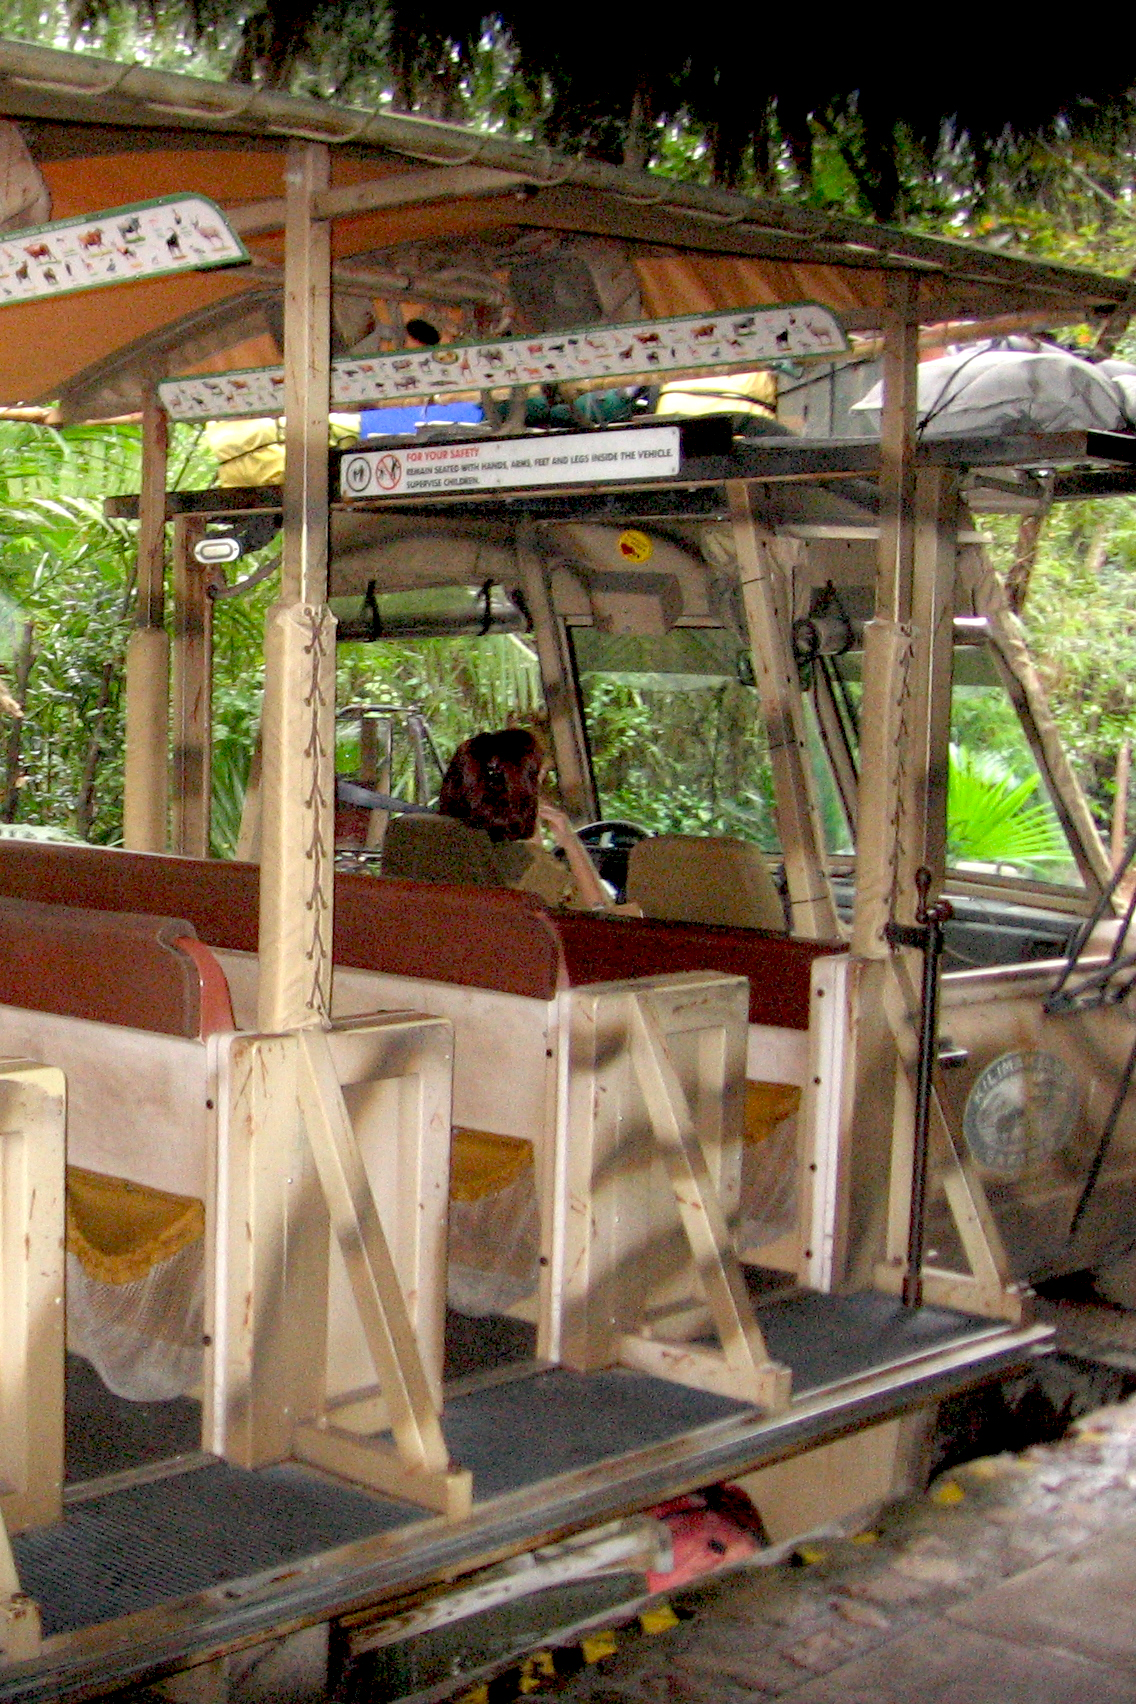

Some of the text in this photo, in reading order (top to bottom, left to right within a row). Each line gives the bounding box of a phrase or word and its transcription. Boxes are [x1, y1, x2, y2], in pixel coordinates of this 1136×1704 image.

[406, 447, 480, 462] FOR YOUR SAFETY
[406, 467, 433, 476] REMAIN
[434, 465, 460, 474] SEATED
[461, 463, 480, 472] WITH
[534, 457, 550, 466] FEET
[552, 456, 569, 464] AND
[570, 454, 590, 464] LEGS
[591, 453, 618, 462] INSIDE
[620, 451, 636, 460] THE
[637, 448, 673, 459] VEHICLE.
[406, 480, 442, 489] SUPERVISE
